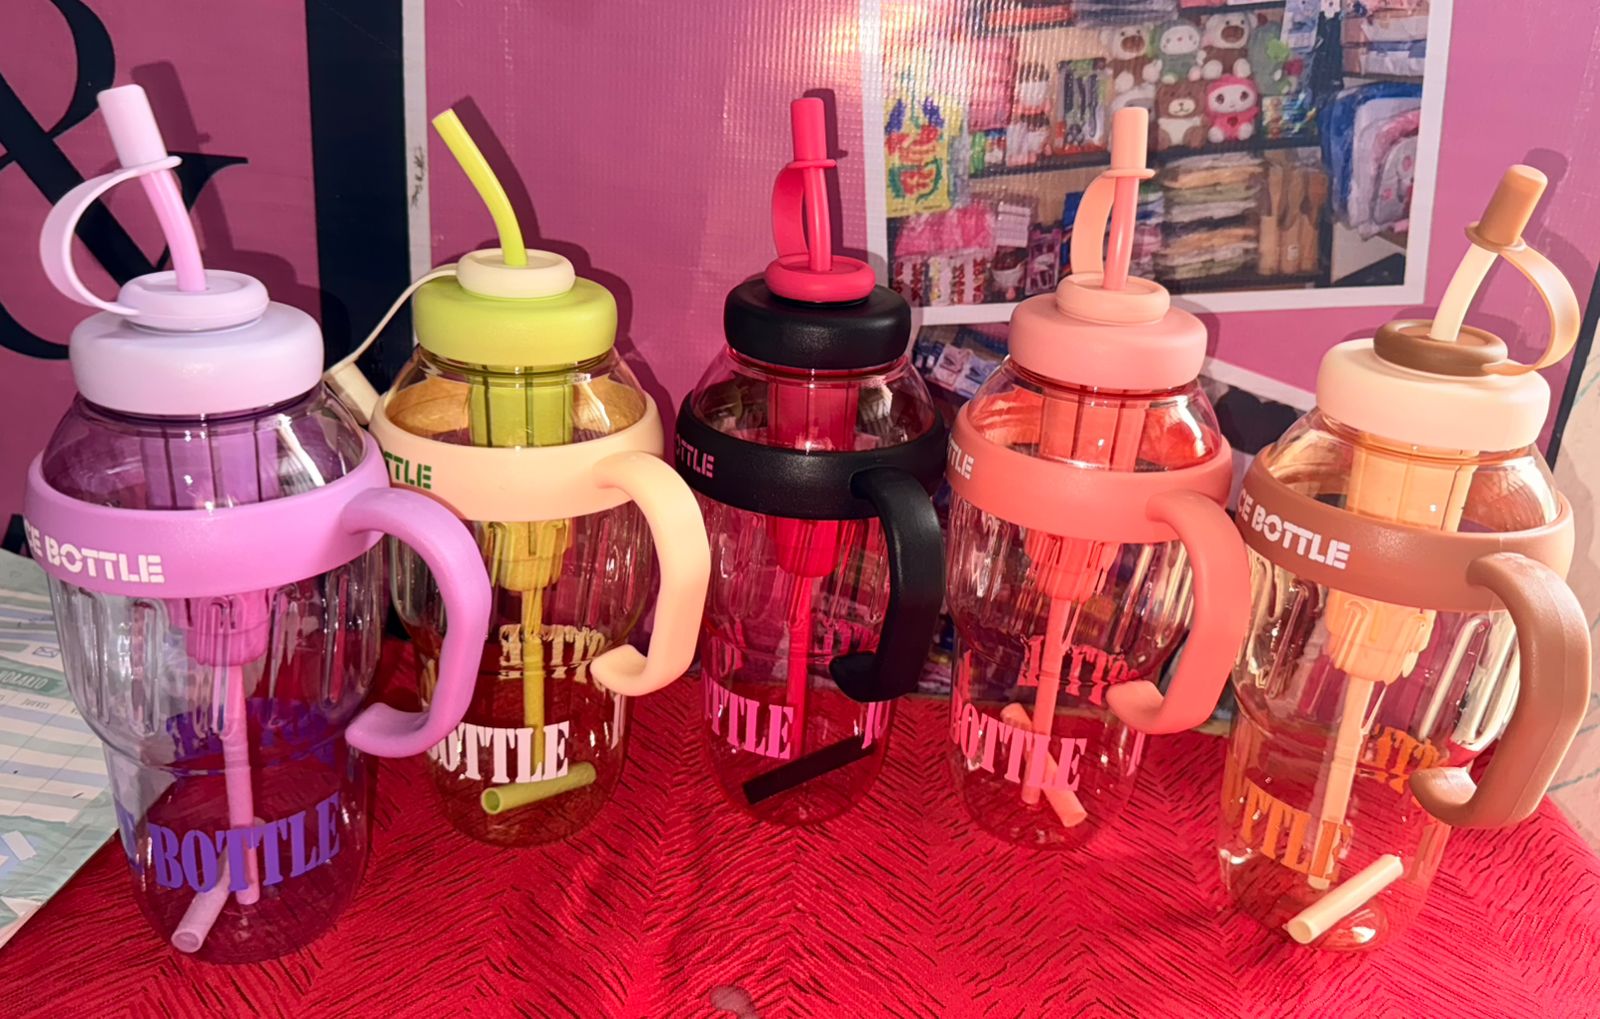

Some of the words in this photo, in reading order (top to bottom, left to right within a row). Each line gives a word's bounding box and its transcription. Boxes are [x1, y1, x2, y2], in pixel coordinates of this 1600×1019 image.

[44, 535, 165, 584] BOTTLE
[1251, 504, 1351, 570] BOTTLE
[147, 791, 339, 893] BOTTLE
